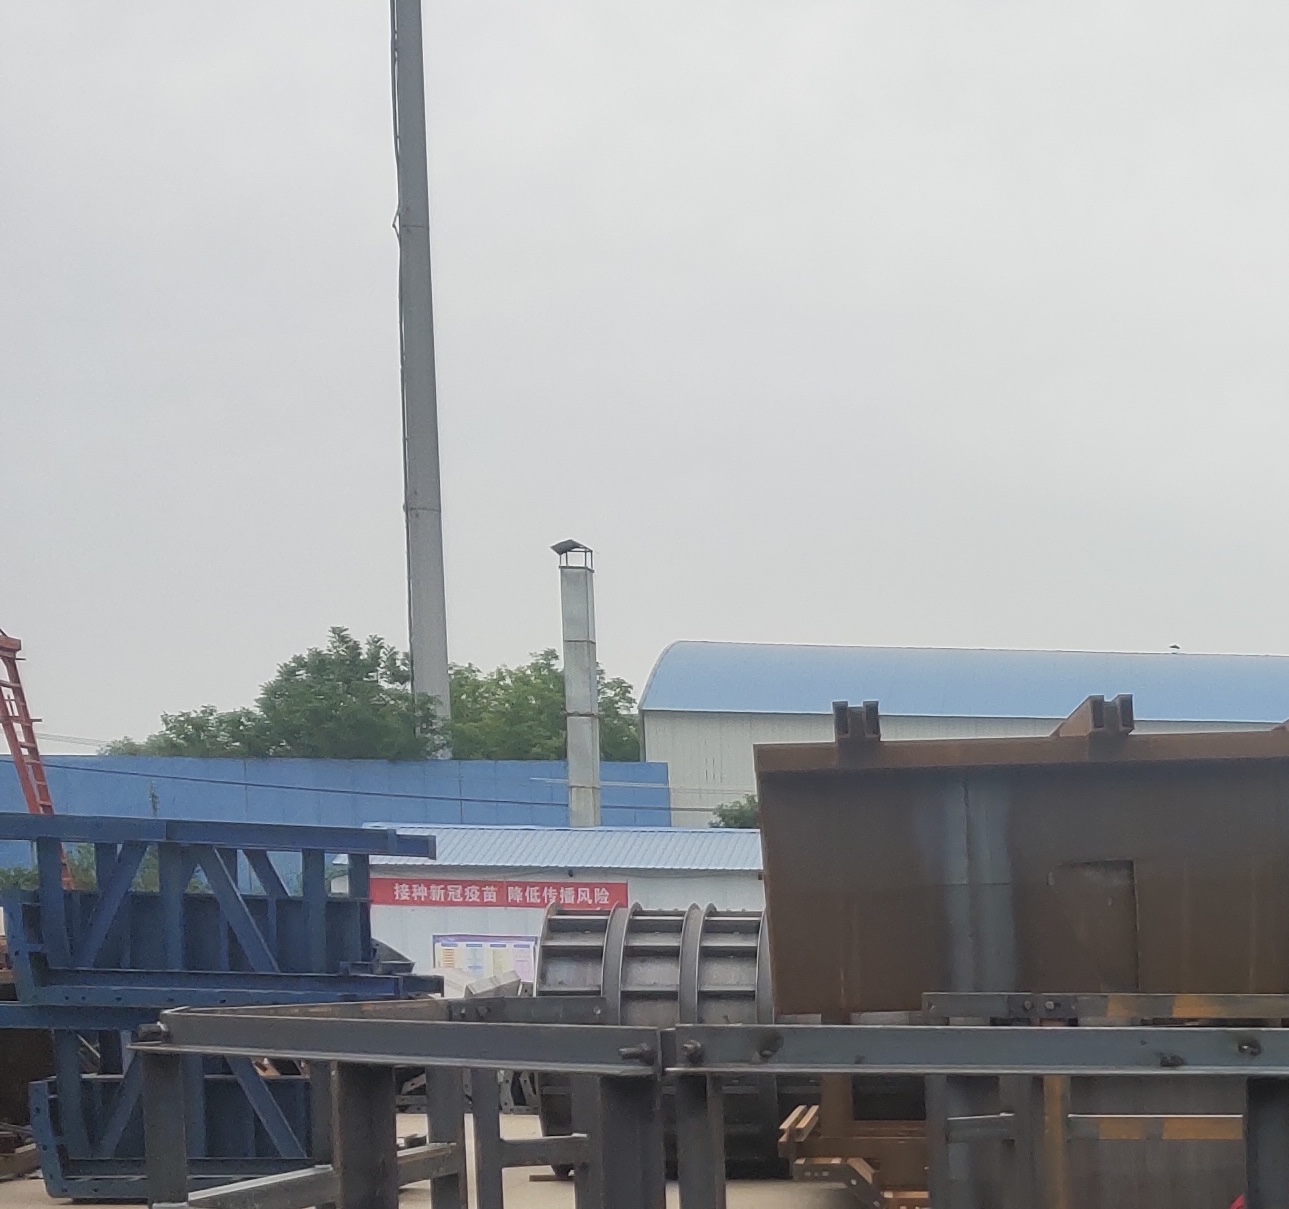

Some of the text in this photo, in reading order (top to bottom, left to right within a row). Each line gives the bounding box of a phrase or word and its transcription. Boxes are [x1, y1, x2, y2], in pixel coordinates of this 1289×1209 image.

[394, 883, 610, 904] 接种新冠疫苗 降低传播风险
